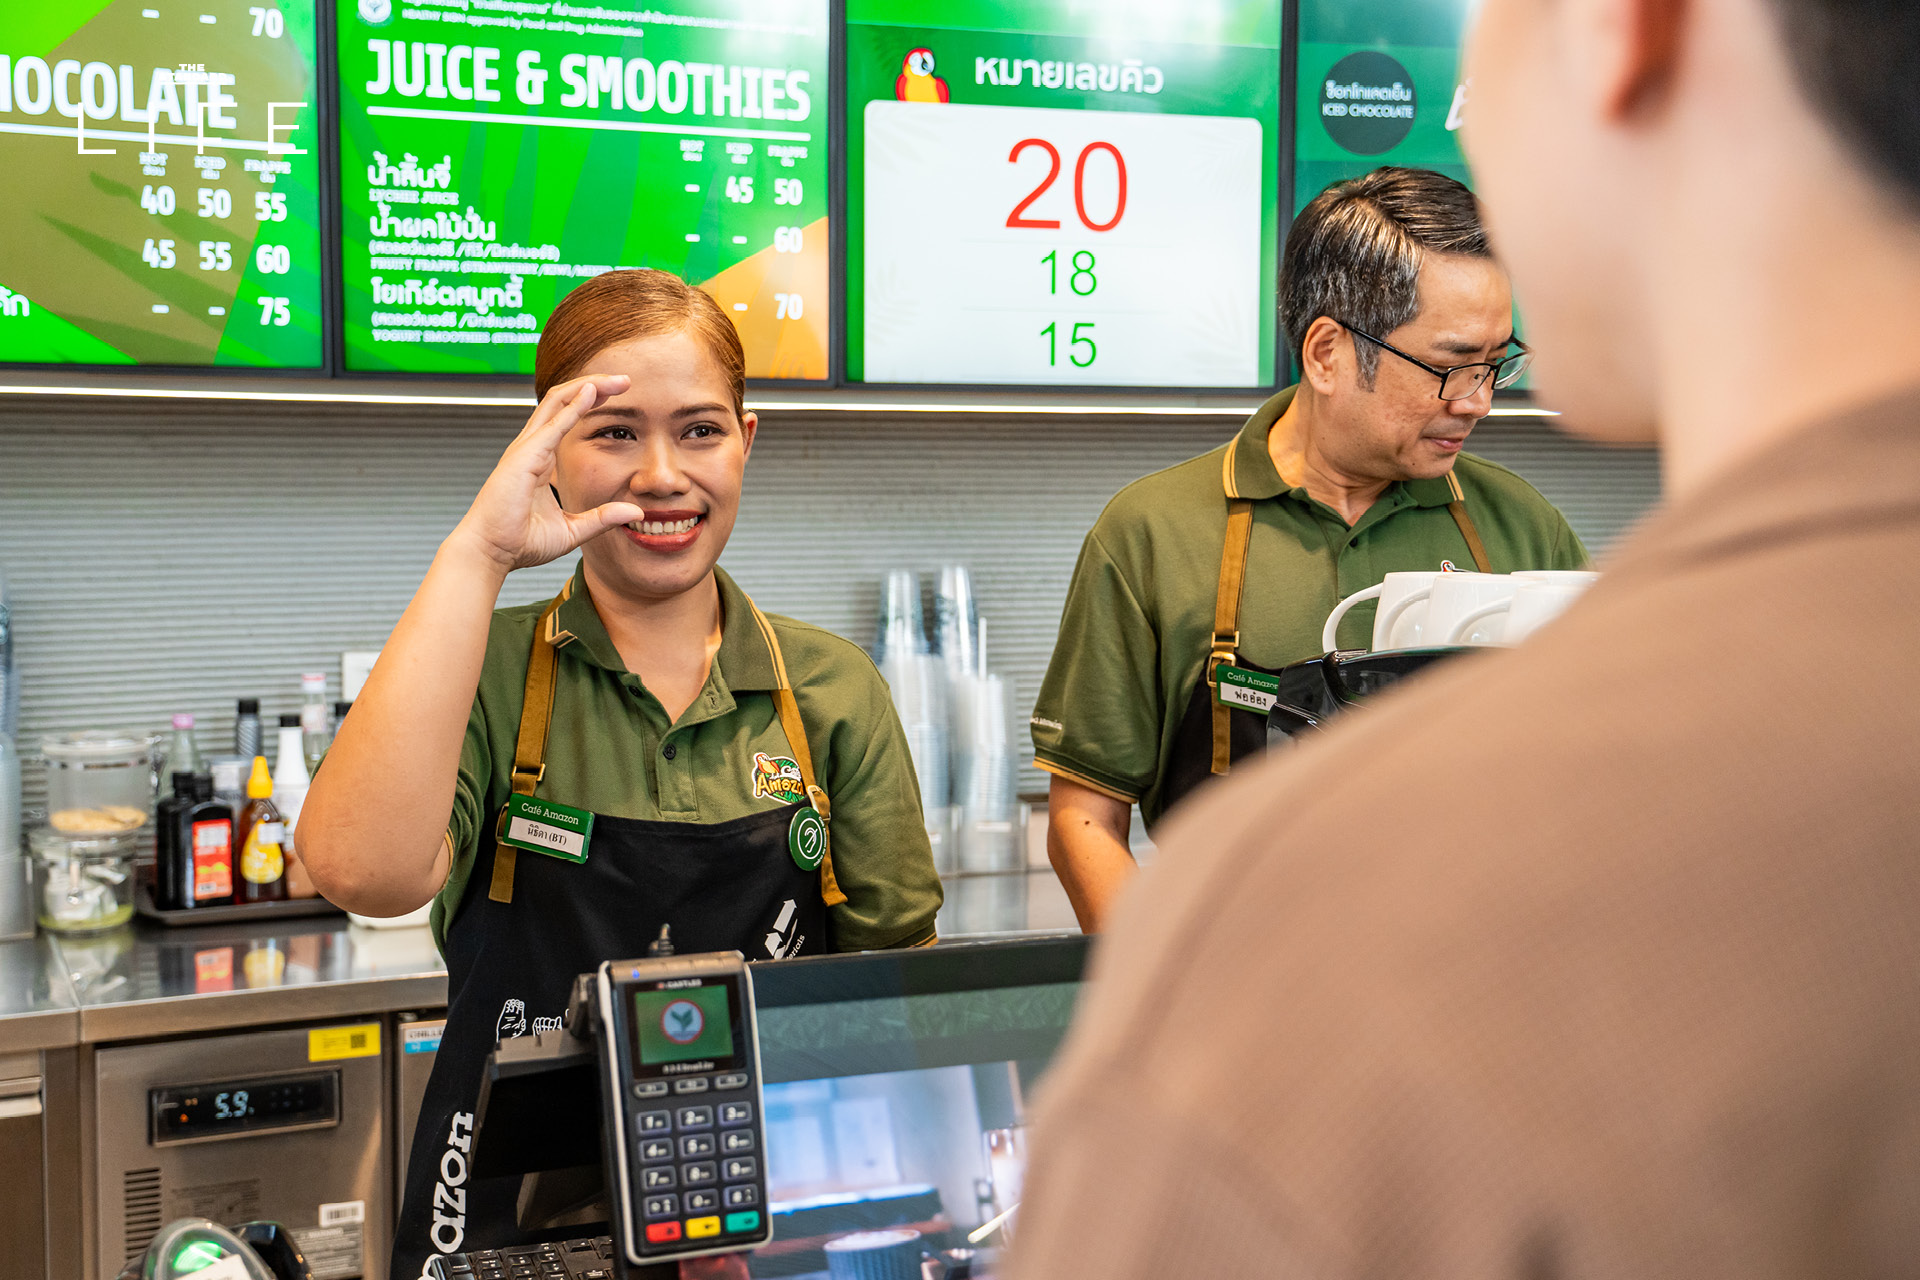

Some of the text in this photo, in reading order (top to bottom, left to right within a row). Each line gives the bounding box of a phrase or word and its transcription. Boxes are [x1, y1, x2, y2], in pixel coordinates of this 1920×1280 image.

[249, 7, 284, 38] 70
[366, 39, 811, 121] JUICE & SMOOTHIES
[975, 56, 1164, 94] หมายเลขคิว
[1322, 103, 1414, 118] ICED CHOCOLATE
[367, 151, 451, 189] น้ำลิ้นจี่
[1004, 137, 1128, 232] 20
[140, 185, 288, 222] 40 50 55
[420, 190, 459, 205] JUICE
[725, 175, 754, 204] 45
[774, 178, 803, 206] 50
[369, 201, 496, 241] น้ำผลไม้ปั่น
[774, 226, 803, 253] 60
[142, 239, 290, 275] 45 55 60
[1040, 250, 1098, 296] 18
[257, 297, 290, 326] 75
[774, 293, 803, 320] 70
[1039, 322, 1098, 368] 15
[1227, 672, 1246, 682] Café
[521, 802, 579, 825] Café Amazon
[649, 1171, 659, 1186] 7
[419, 1111, 474, 1280] azon
